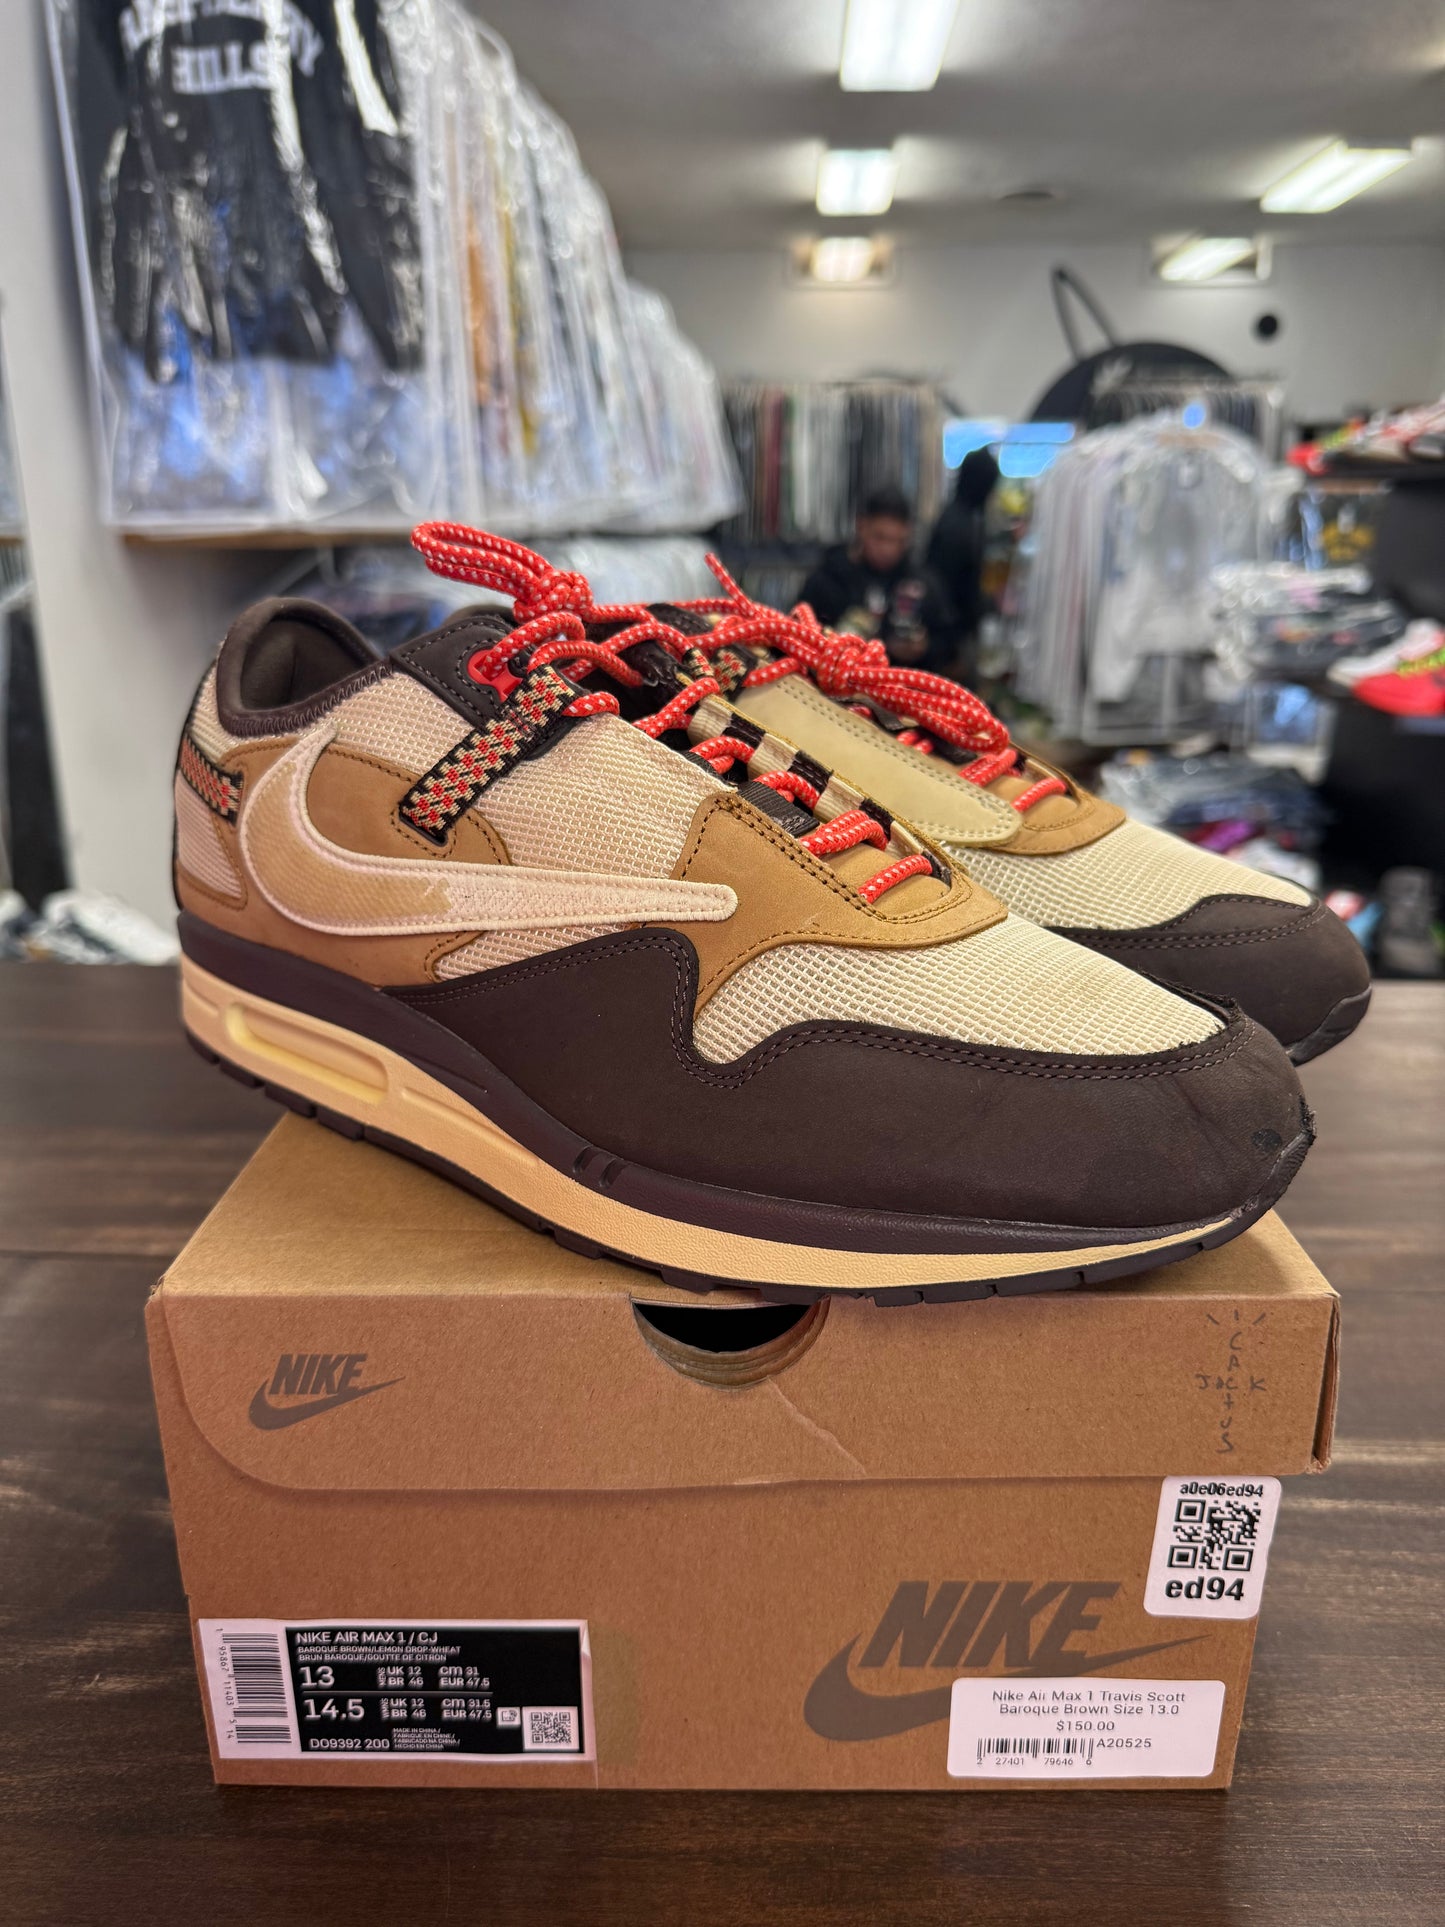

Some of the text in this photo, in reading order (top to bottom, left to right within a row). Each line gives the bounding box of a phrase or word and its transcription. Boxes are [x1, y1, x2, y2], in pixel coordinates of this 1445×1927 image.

[269, 1354, 368, 1395] NIKE
[1180, 1482, 1264, 1497] a0e06ed94
[1165, 1576, 1245, 1601] ed94
[857, 1581, 1121, 1668] NIKE
[296, 1631, 332, 1643] NIKE
[335, 1631, 359, 1643] AIR
[362, 1631, 395, 1643] MAX
[398, 1632, 406, 1642] 1
[418, 1631, 438, 1643] CJ
[219, 1645, 230, 1672] 95867
[300, 1666, 335, 1686] 13
[387, 1666, 422, 1675] UK 12
[466, 1667, 479, 1676] 31
[388, 1677, 424, 1686] BR 46
[440, 1677, 490, 1686] EUR 47.5
[224, 1681, 235, 1706] 11403
[992, 1690, 1024, 1701] Nike
[1052, 1691, 1082, 1701] Max
[1099, 1691, 1142, 1702] Travis
[1147, 1692, 1185, 1702] Scott
[391, 1698, 424, 1707] UK 12
[468, 1699, 490, 1708] 31.5
[304, 1699, 365, 1719] 14.5
[391, 1709, 426, 1717] BR 46
[443, 1710, 492, 1718] EUR 47.5
[1000, 1704, 1179, 1716] Baroque Brown Size 13.0
[1056, 1720, 1115, 1732] $150.00
[365, 1739, 390, 1749] 200
[1096, 1738, 1152, 1748] A20525
[995, 1757, 1024, 1765] 27401
[1044, 1757, 1074, 1766] 79646
